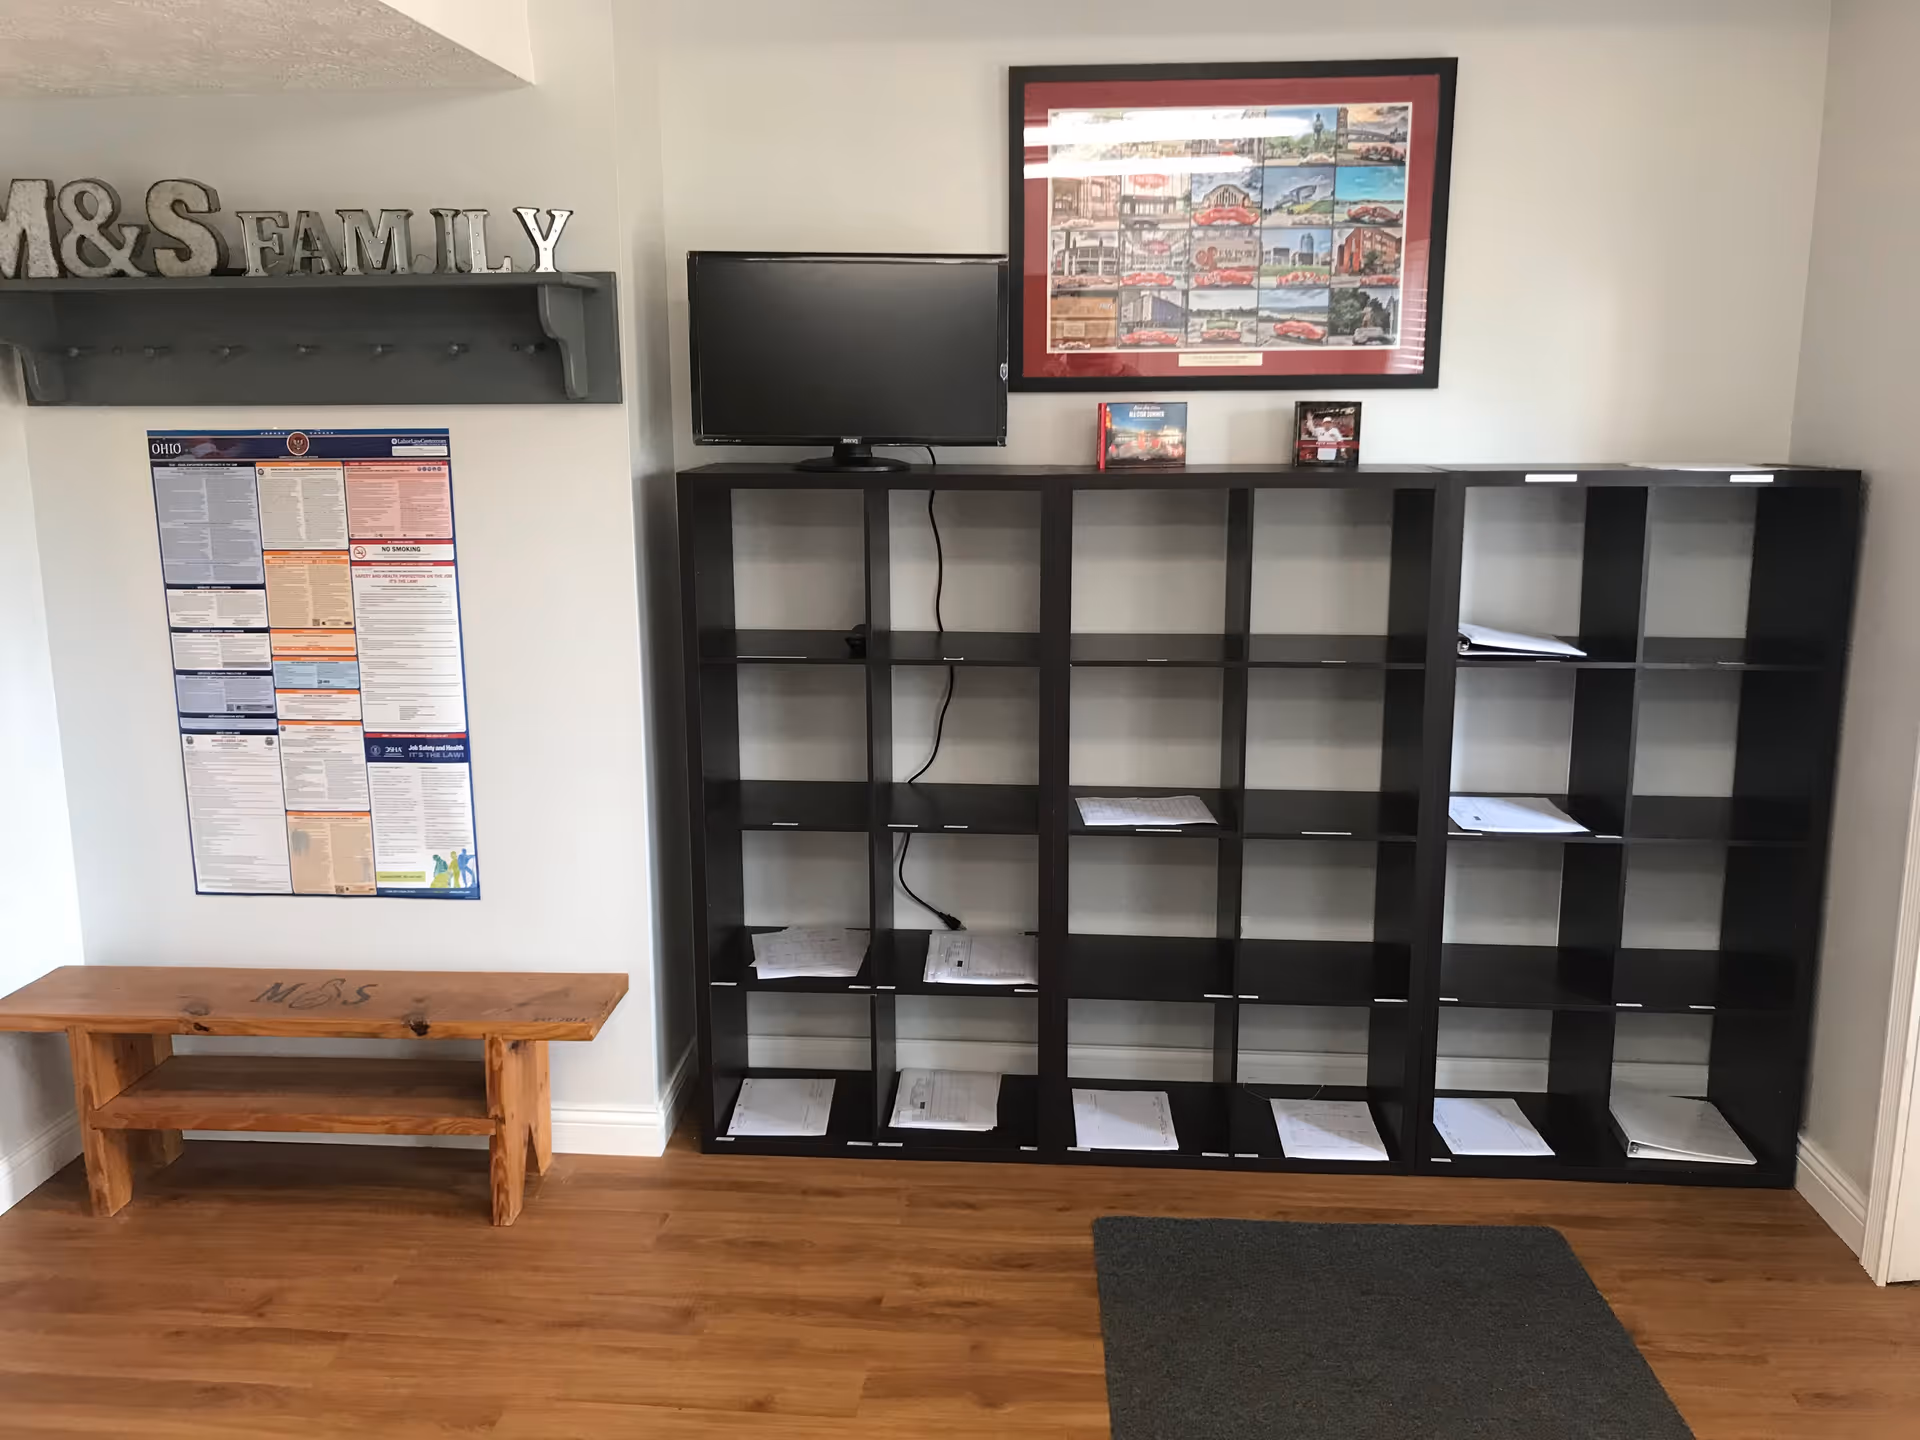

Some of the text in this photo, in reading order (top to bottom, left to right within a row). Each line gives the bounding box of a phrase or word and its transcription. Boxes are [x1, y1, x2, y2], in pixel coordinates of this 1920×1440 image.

[236, 207, 574, 276] FAMILY
[151, 443, 182, 455] OHIO
[419, 744, 435, 752] Safety
